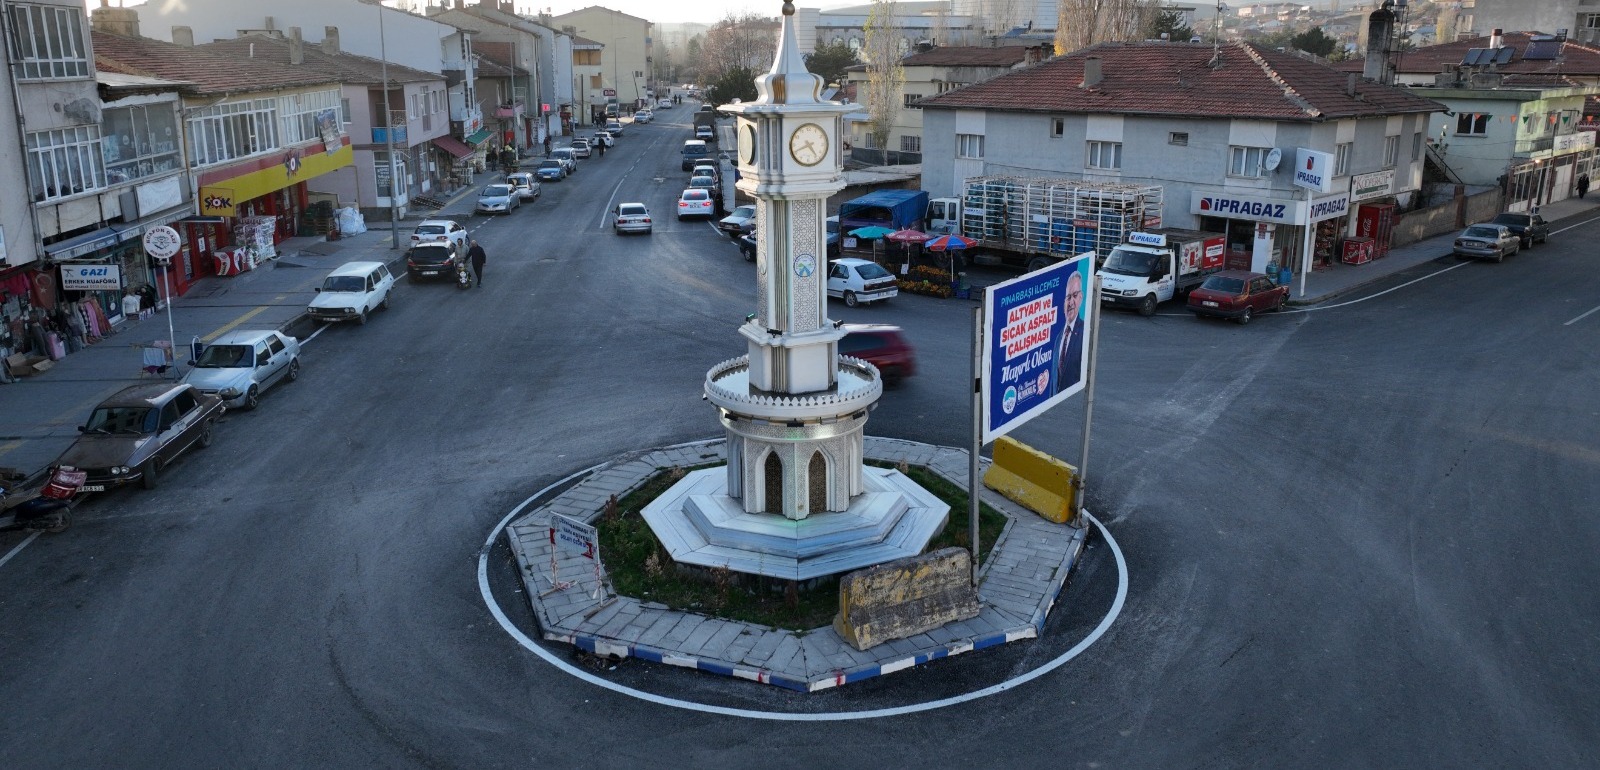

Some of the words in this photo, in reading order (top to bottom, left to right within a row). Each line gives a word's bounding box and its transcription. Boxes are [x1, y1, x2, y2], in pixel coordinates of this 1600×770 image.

[204, 196, 233, 210] ŞOK
[80, 266, 108, 276] GAZİ
[1001, 286, 1034, 308] PINARBAŞI
[1009, 300, 1042, 324] ALTYAPI
[1043, 298, 1051, 310] ve
[1002, 321, 1027, 343] SICAK
[1028, 309, 1056, 331] ASFALT
[1007, 327, 1050, 358] ÇALIŞMASI
[1001, 352, 1031, 384] Hayırlı
[1031, 347, 1052, 369] Olsun
